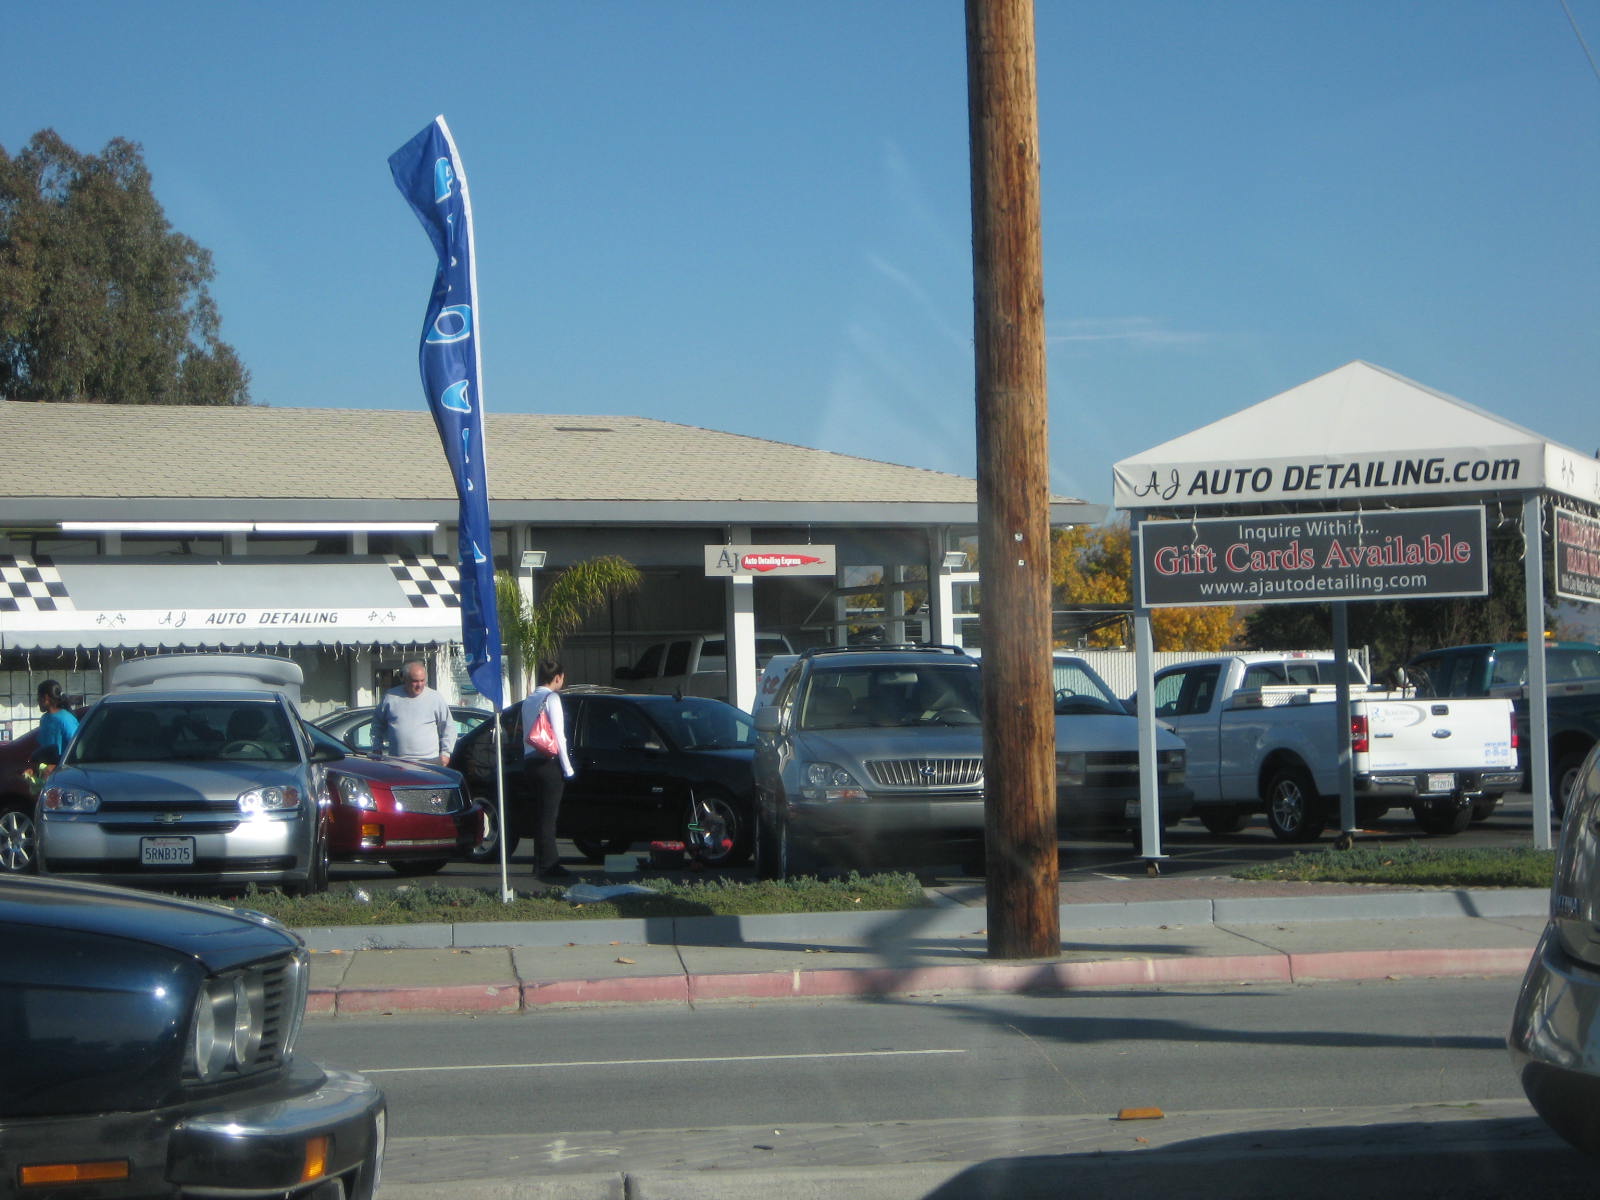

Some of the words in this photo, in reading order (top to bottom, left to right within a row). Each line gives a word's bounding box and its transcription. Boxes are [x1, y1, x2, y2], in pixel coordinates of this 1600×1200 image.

[1187, 467, 1273, 496] AUTO
[1282, 458, 1521, 492] DETAILING.com
[1239, 523, 1301, 542] Inquire
[745, 556, 758, 565] Auto
[757, 556, 780, 566] Detailing
[1154, 543, 1217, 575] Gift
[1225, 539, 1316, 572] Cards
[1322, 533, 1471, 569] Available
[1200, 574, 1428, 597] www.ajautodetailing.com
[205, 611, 247, 625] AUTO
[258, 611, 338, 625] DETAILING
[145, 847, 190, 860] 5RNB375
